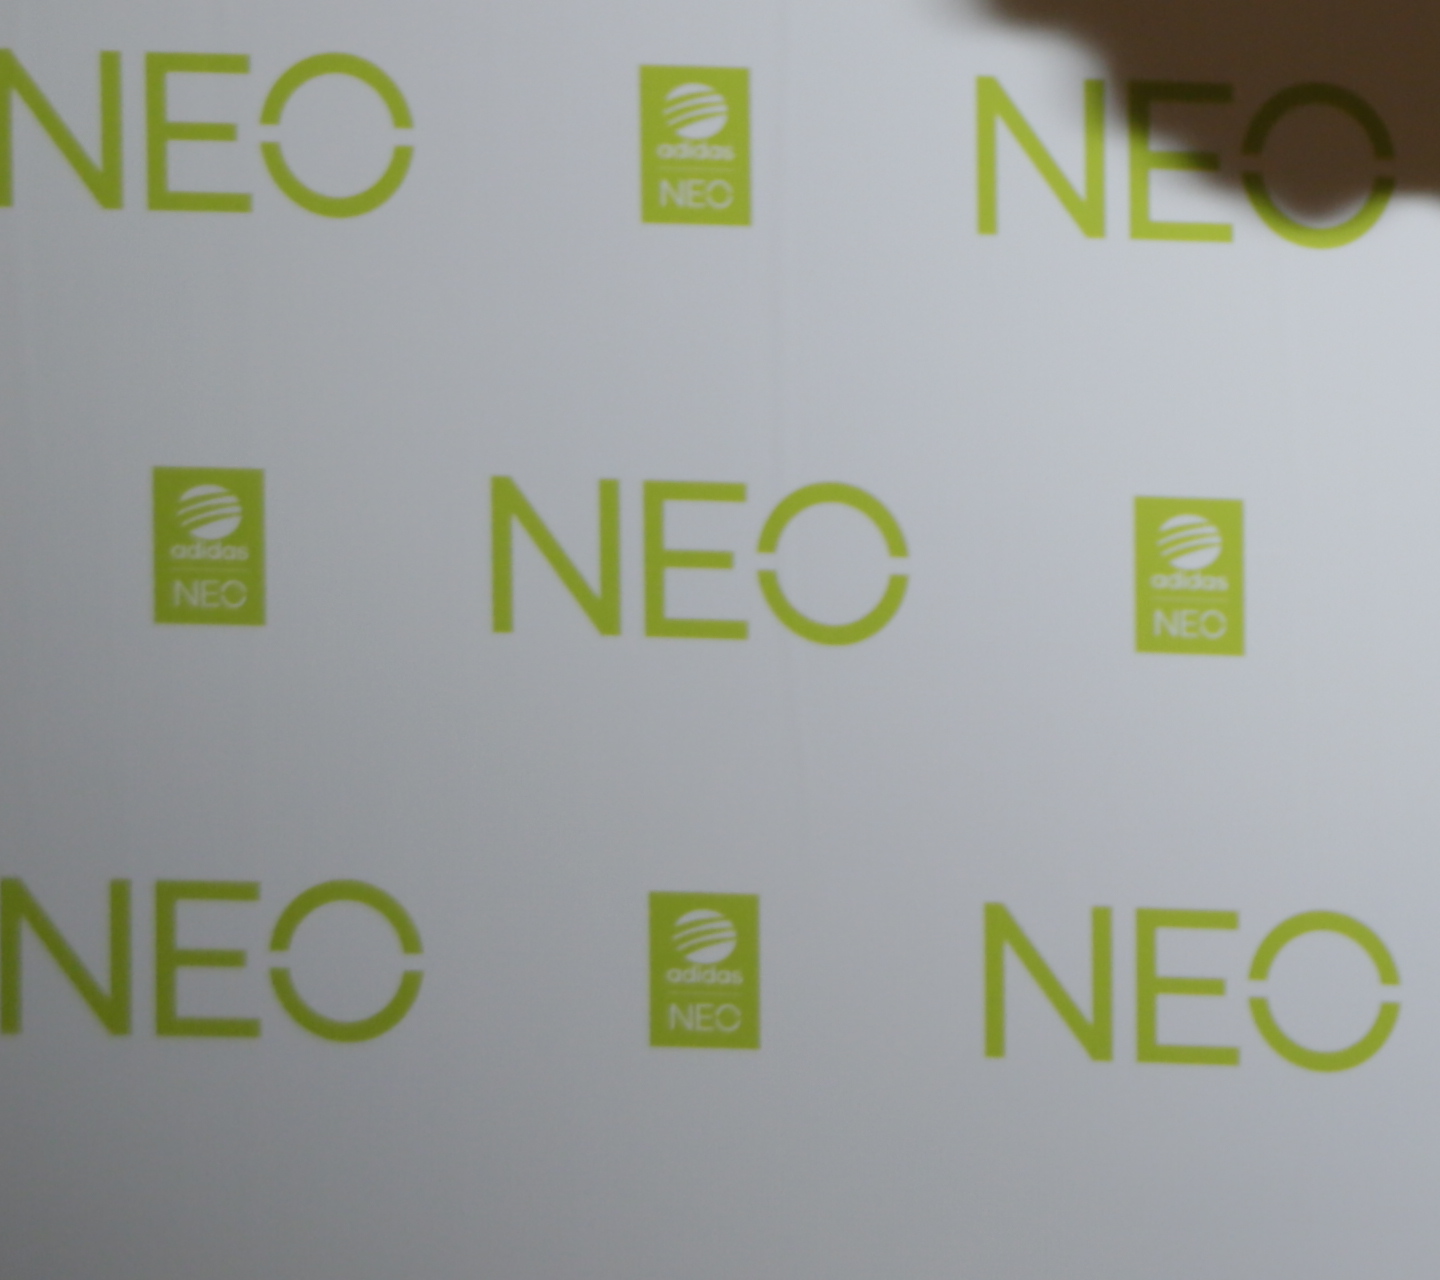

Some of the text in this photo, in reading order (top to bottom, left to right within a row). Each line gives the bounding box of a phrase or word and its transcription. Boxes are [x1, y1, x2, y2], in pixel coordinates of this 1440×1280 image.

[0, 48, 413, 219] NEO
[655, 139, 733, 160] adidas
[976, 76, 1396, 249] NEO
[659, 177, 732, 209] NEO
[168, 540, 247, 560] adidas
[491, 476, 907, 646] NEO
[171, 577, 246, 609] NEO
[1150, 570, 1227, 591] adidas
[1153, 607, 1226, 639] NEO
[0, 876, 423, 1044] NEO
[664, 963, 743, 984] adidas
[984, 903, 1399, 1073] NEO
[667, 1001, 741, 1033] NEO
